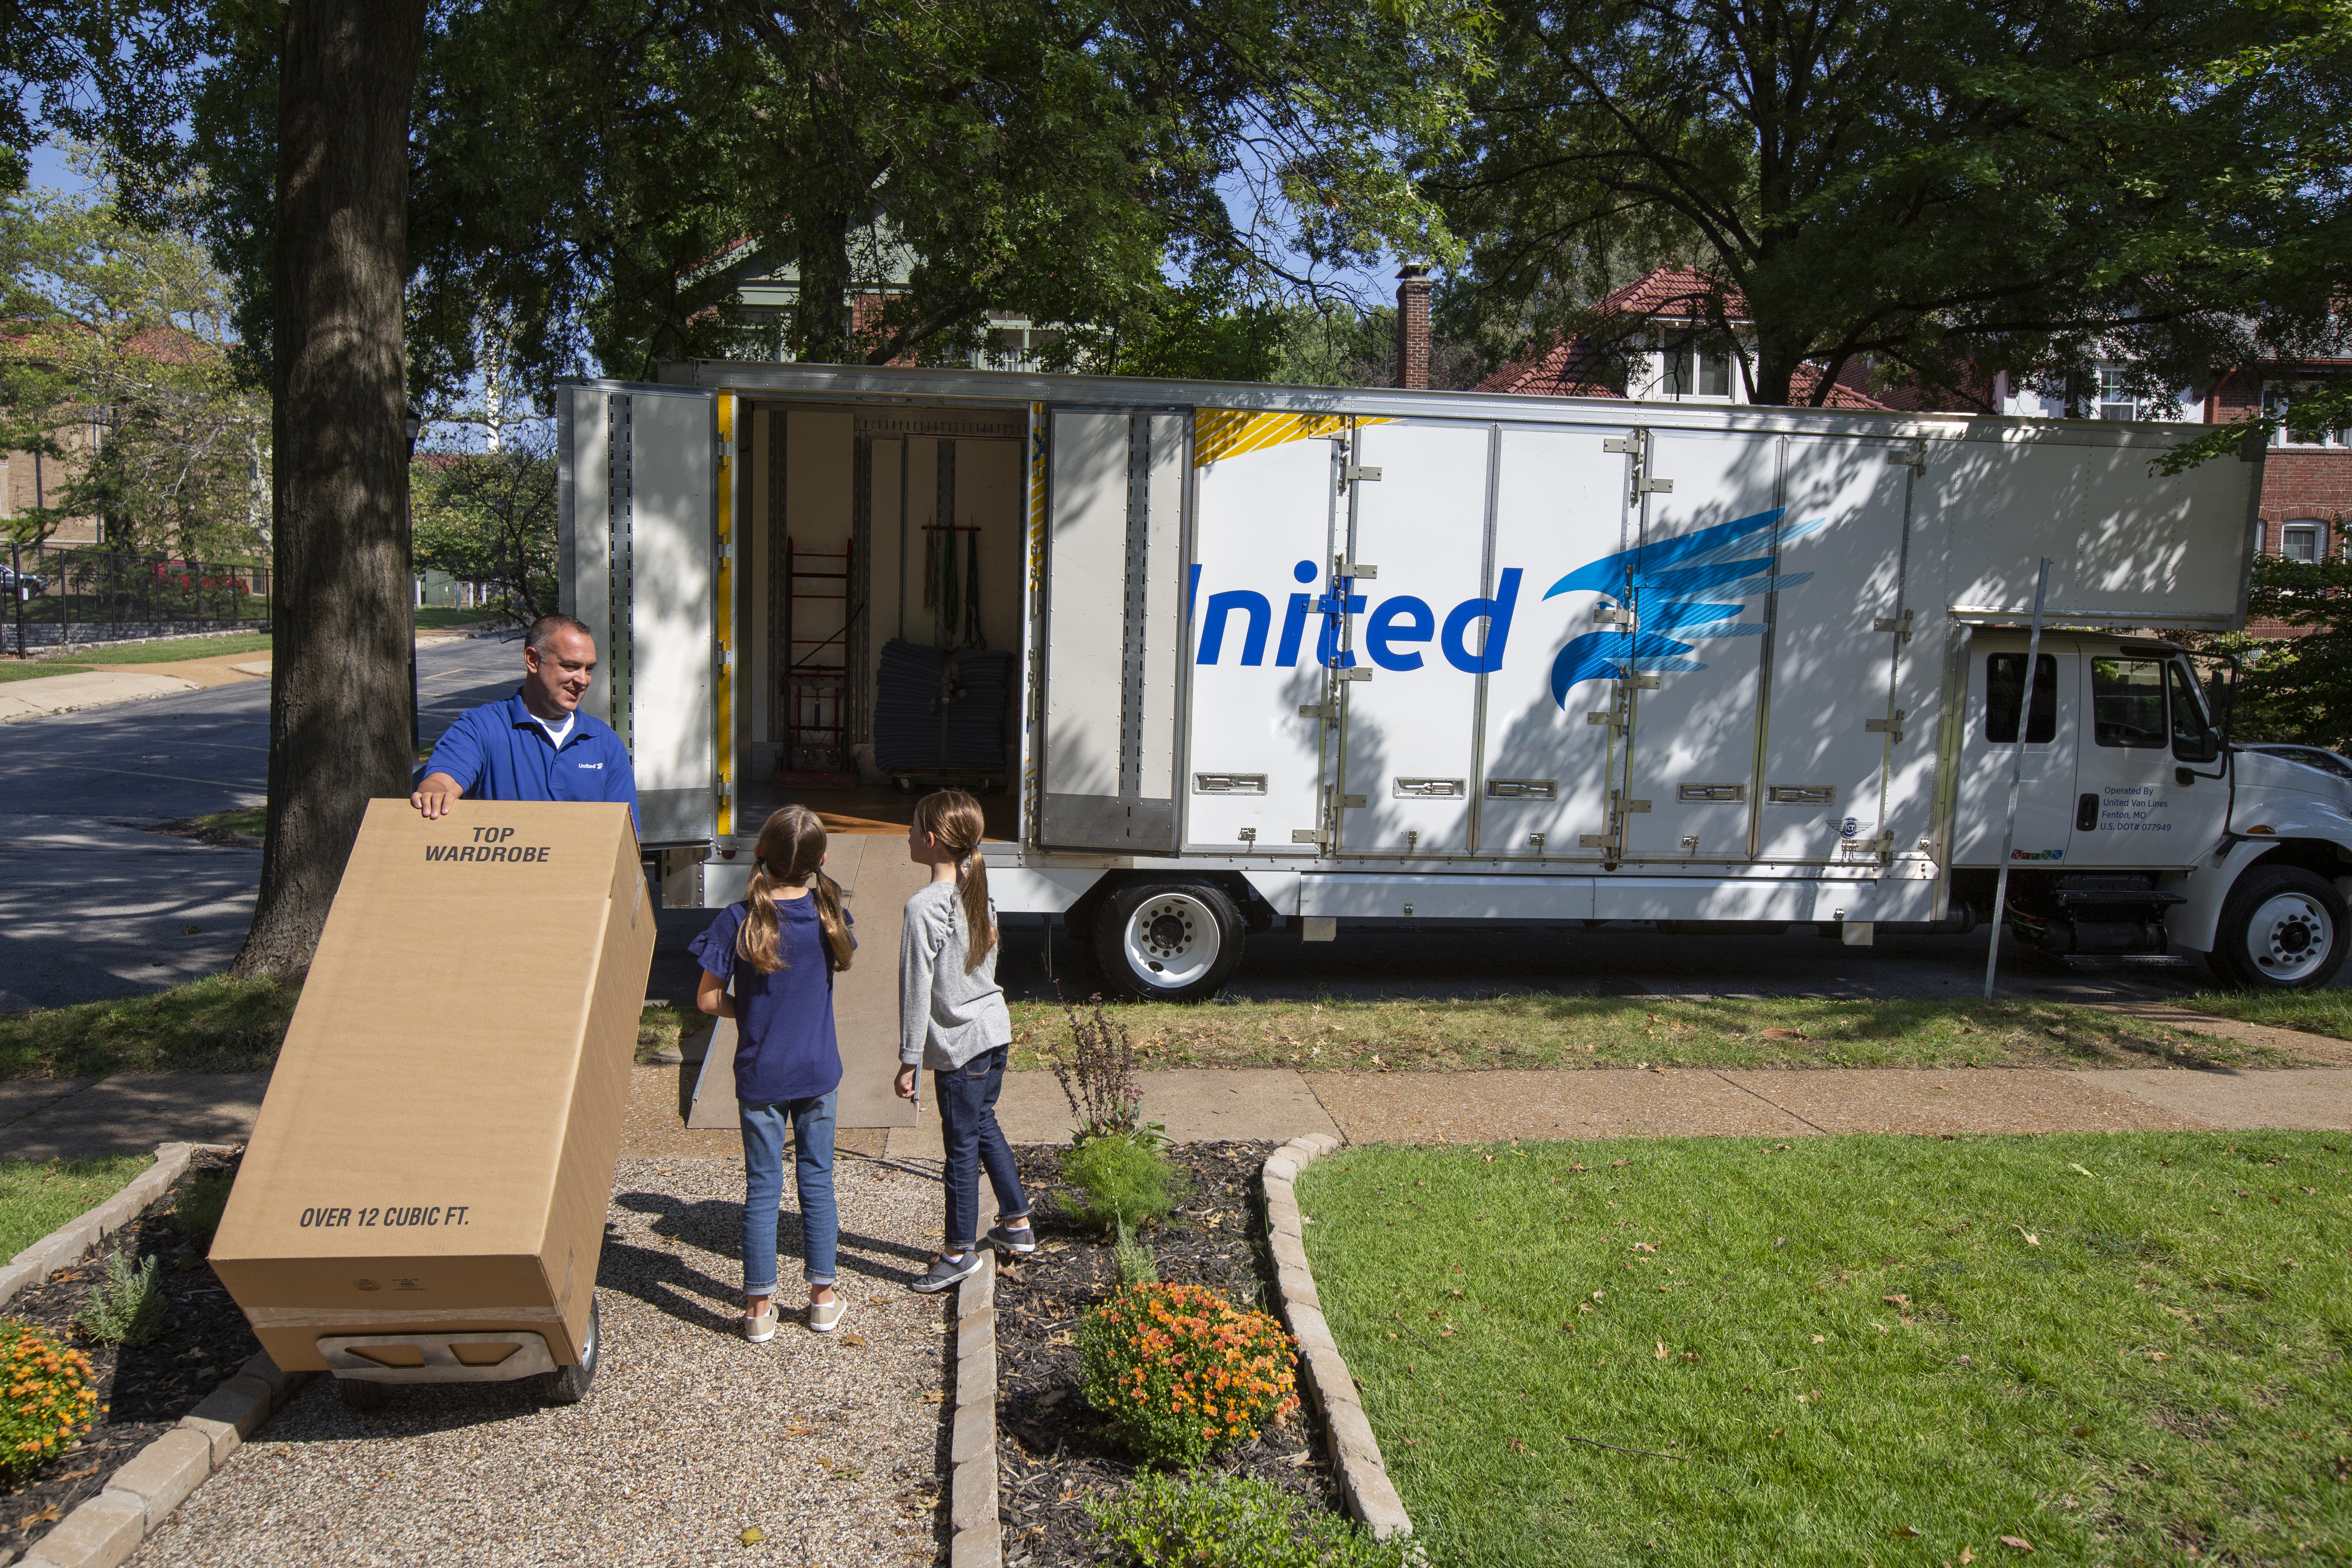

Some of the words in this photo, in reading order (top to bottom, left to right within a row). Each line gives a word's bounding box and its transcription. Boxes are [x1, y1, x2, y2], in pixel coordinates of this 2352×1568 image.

[1189, 560, 1523, 674] nited
[2104, 786, 2141, 796] Operated
[2143, 787, 2154, 796] By
[2102, 811, 2131, 820] Fenton,
[2100, 822, 2115, 831] U.S.
[2117, 822, 2140, 831] DOT#
[2141, 823, 2172, 831] 077949
[472, 827, 515, 843] TOP
[425, 846, 551, 862] WARDROBE
[300, 1208, 352, 1227] OVER
[358, 1207, 380, 1227] 12
[383, 1207, 441, 1226] CUBIC
[444, 1206, 469, 1225] FT.
